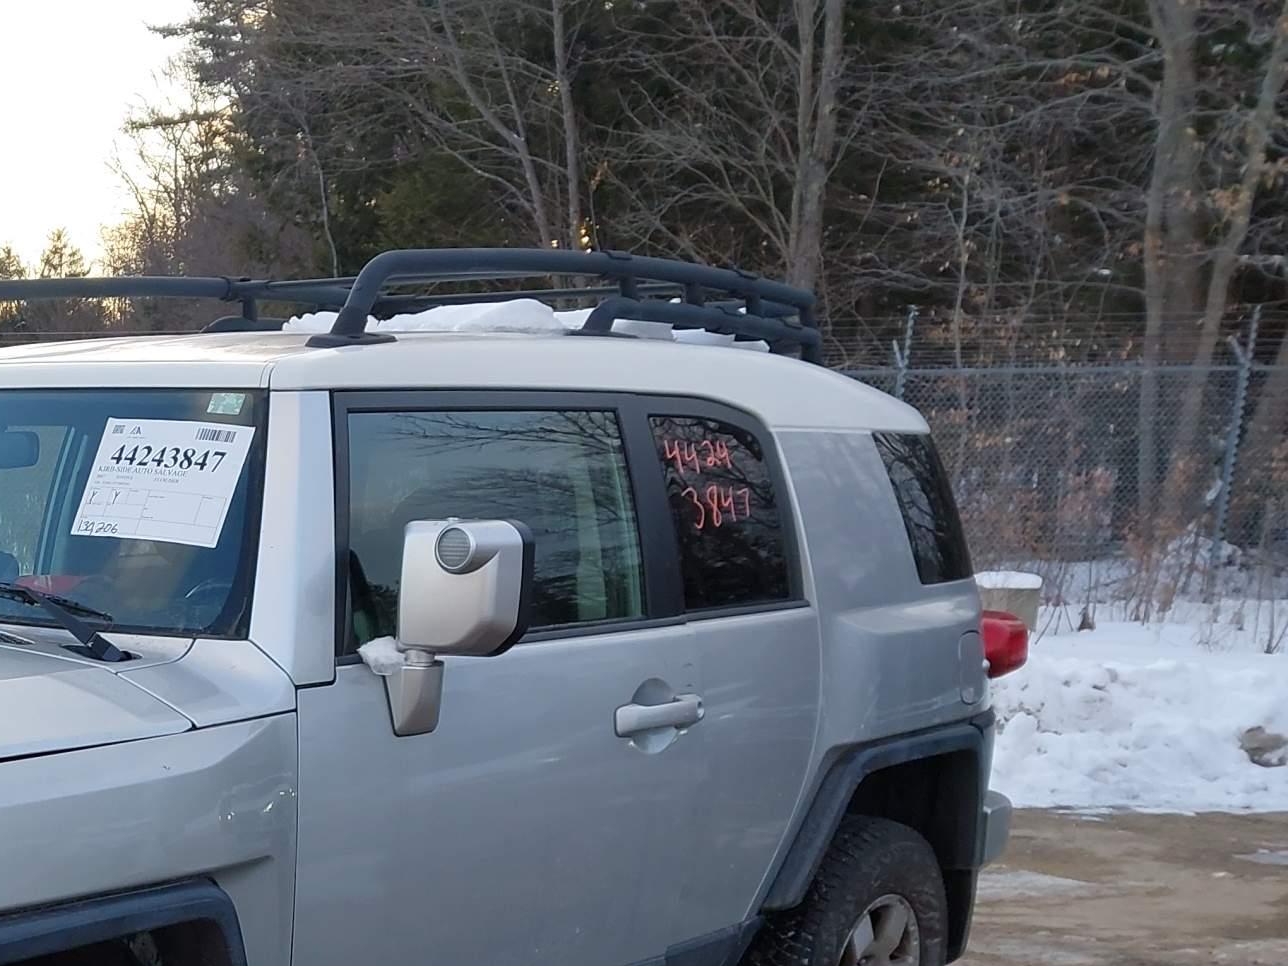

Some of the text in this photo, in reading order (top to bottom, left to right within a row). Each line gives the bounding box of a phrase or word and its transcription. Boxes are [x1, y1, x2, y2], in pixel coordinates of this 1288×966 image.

[111, 444, 227, 473] 44243847
[664, 439, 732, 474] 4424
[681, 484, 750, 529] 3847
